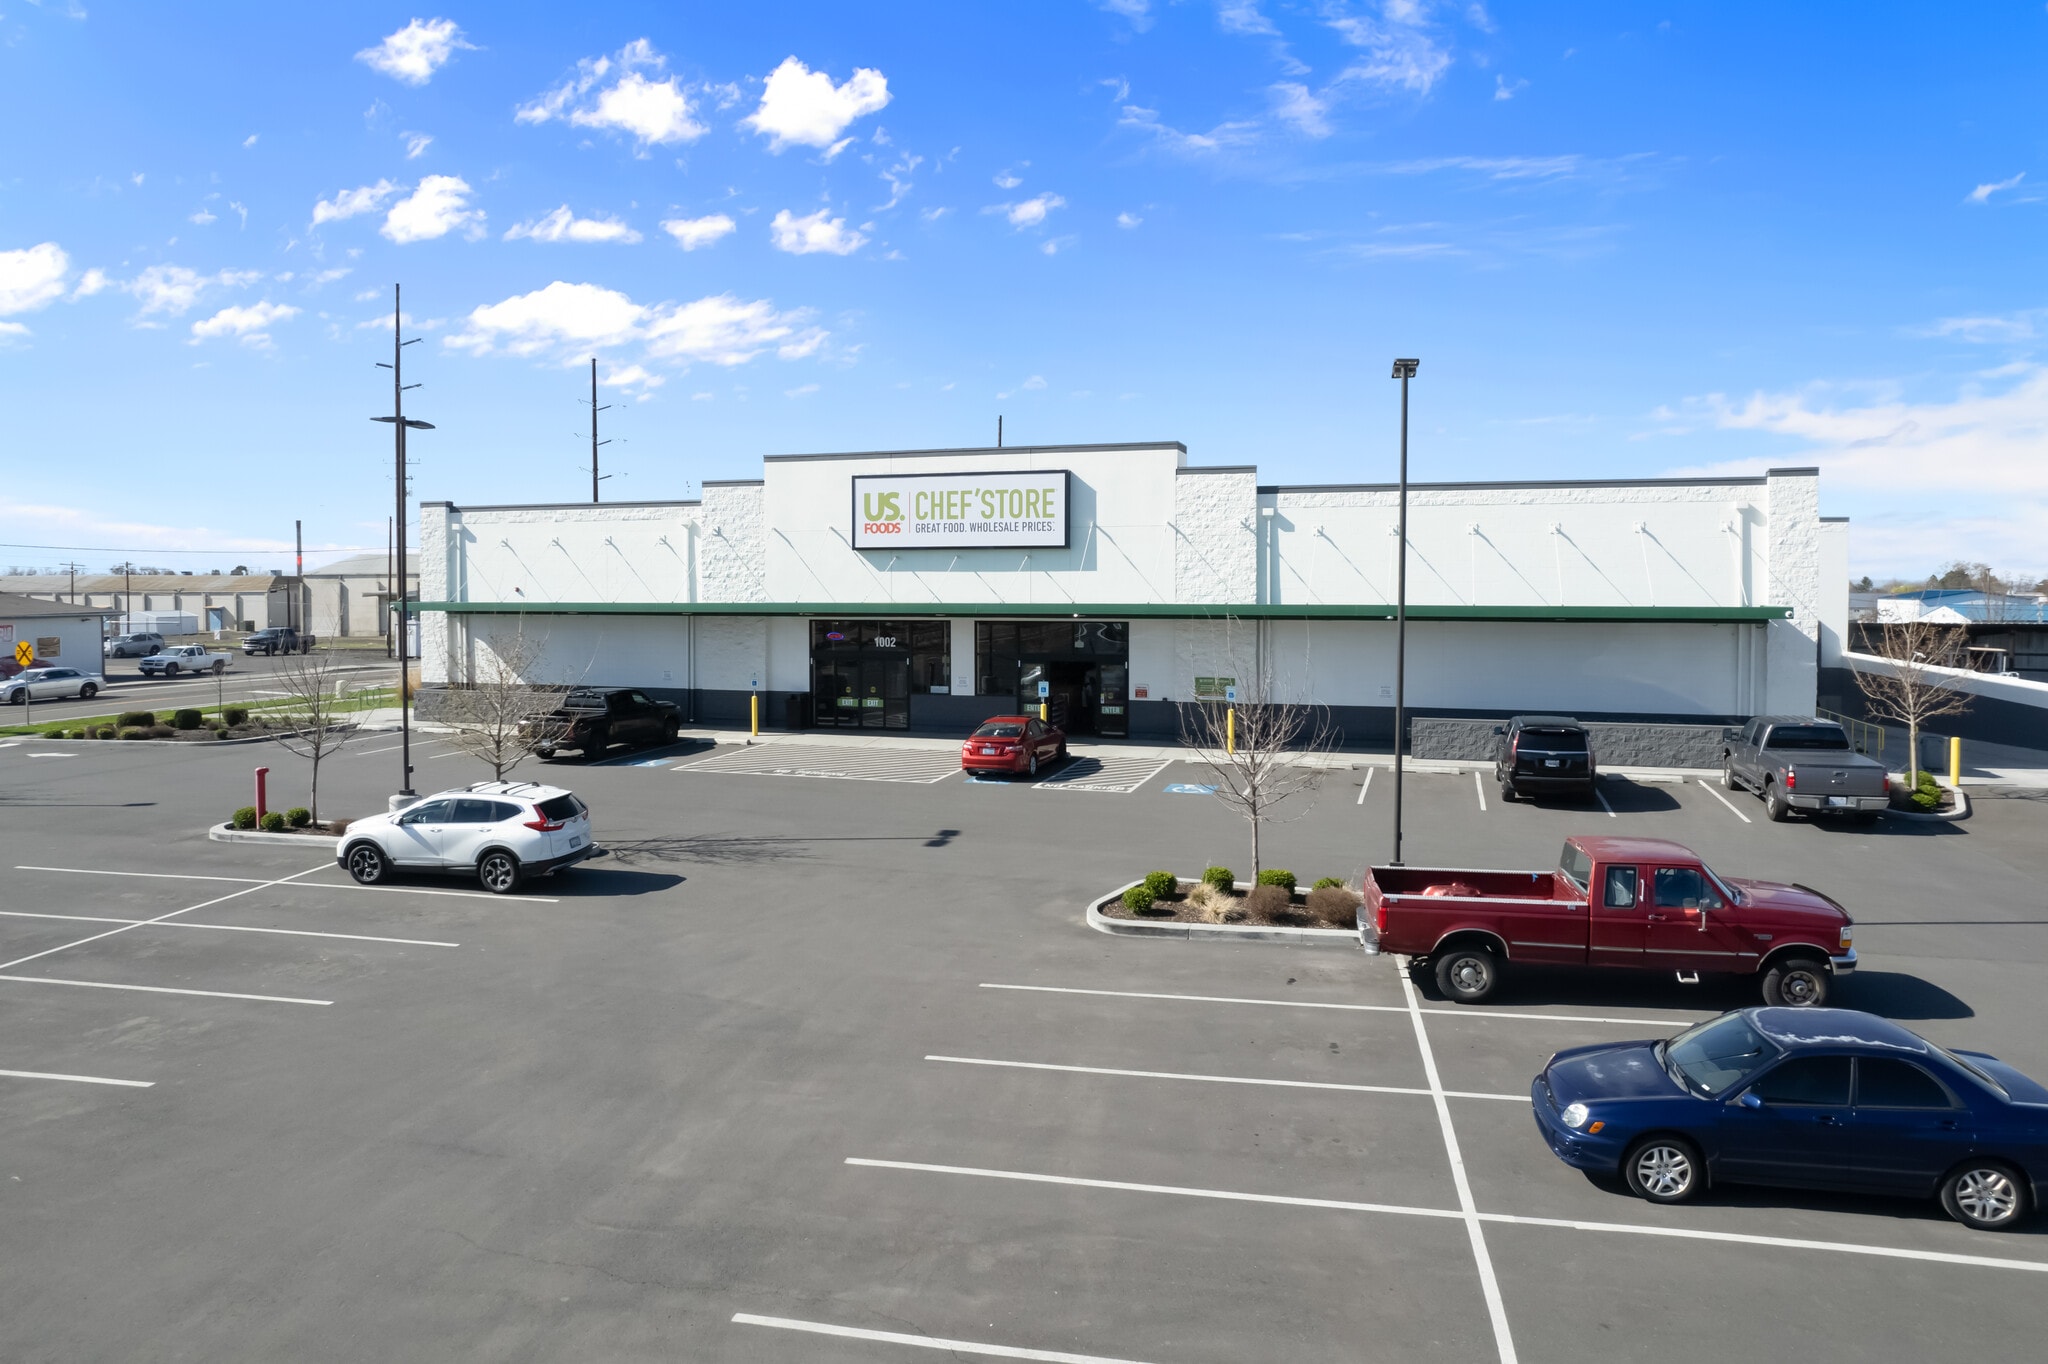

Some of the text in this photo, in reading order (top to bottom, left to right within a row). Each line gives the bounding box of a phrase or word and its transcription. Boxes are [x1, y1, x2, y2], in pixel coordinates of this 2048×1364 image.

[915, 487, 1055, 521] CHEF'STORE
[864, 522, 901, 535] FOODS
[915, 521, 1055, 534] GREAT FOOD. WHOLESALE PRICES.
[874, 636, 897, 648] 1002
[867, 699, 879, 707] EXIT
[1026, 704, 1041, 712] ENTE
[1102, 706, 1120, 714] ENTER
